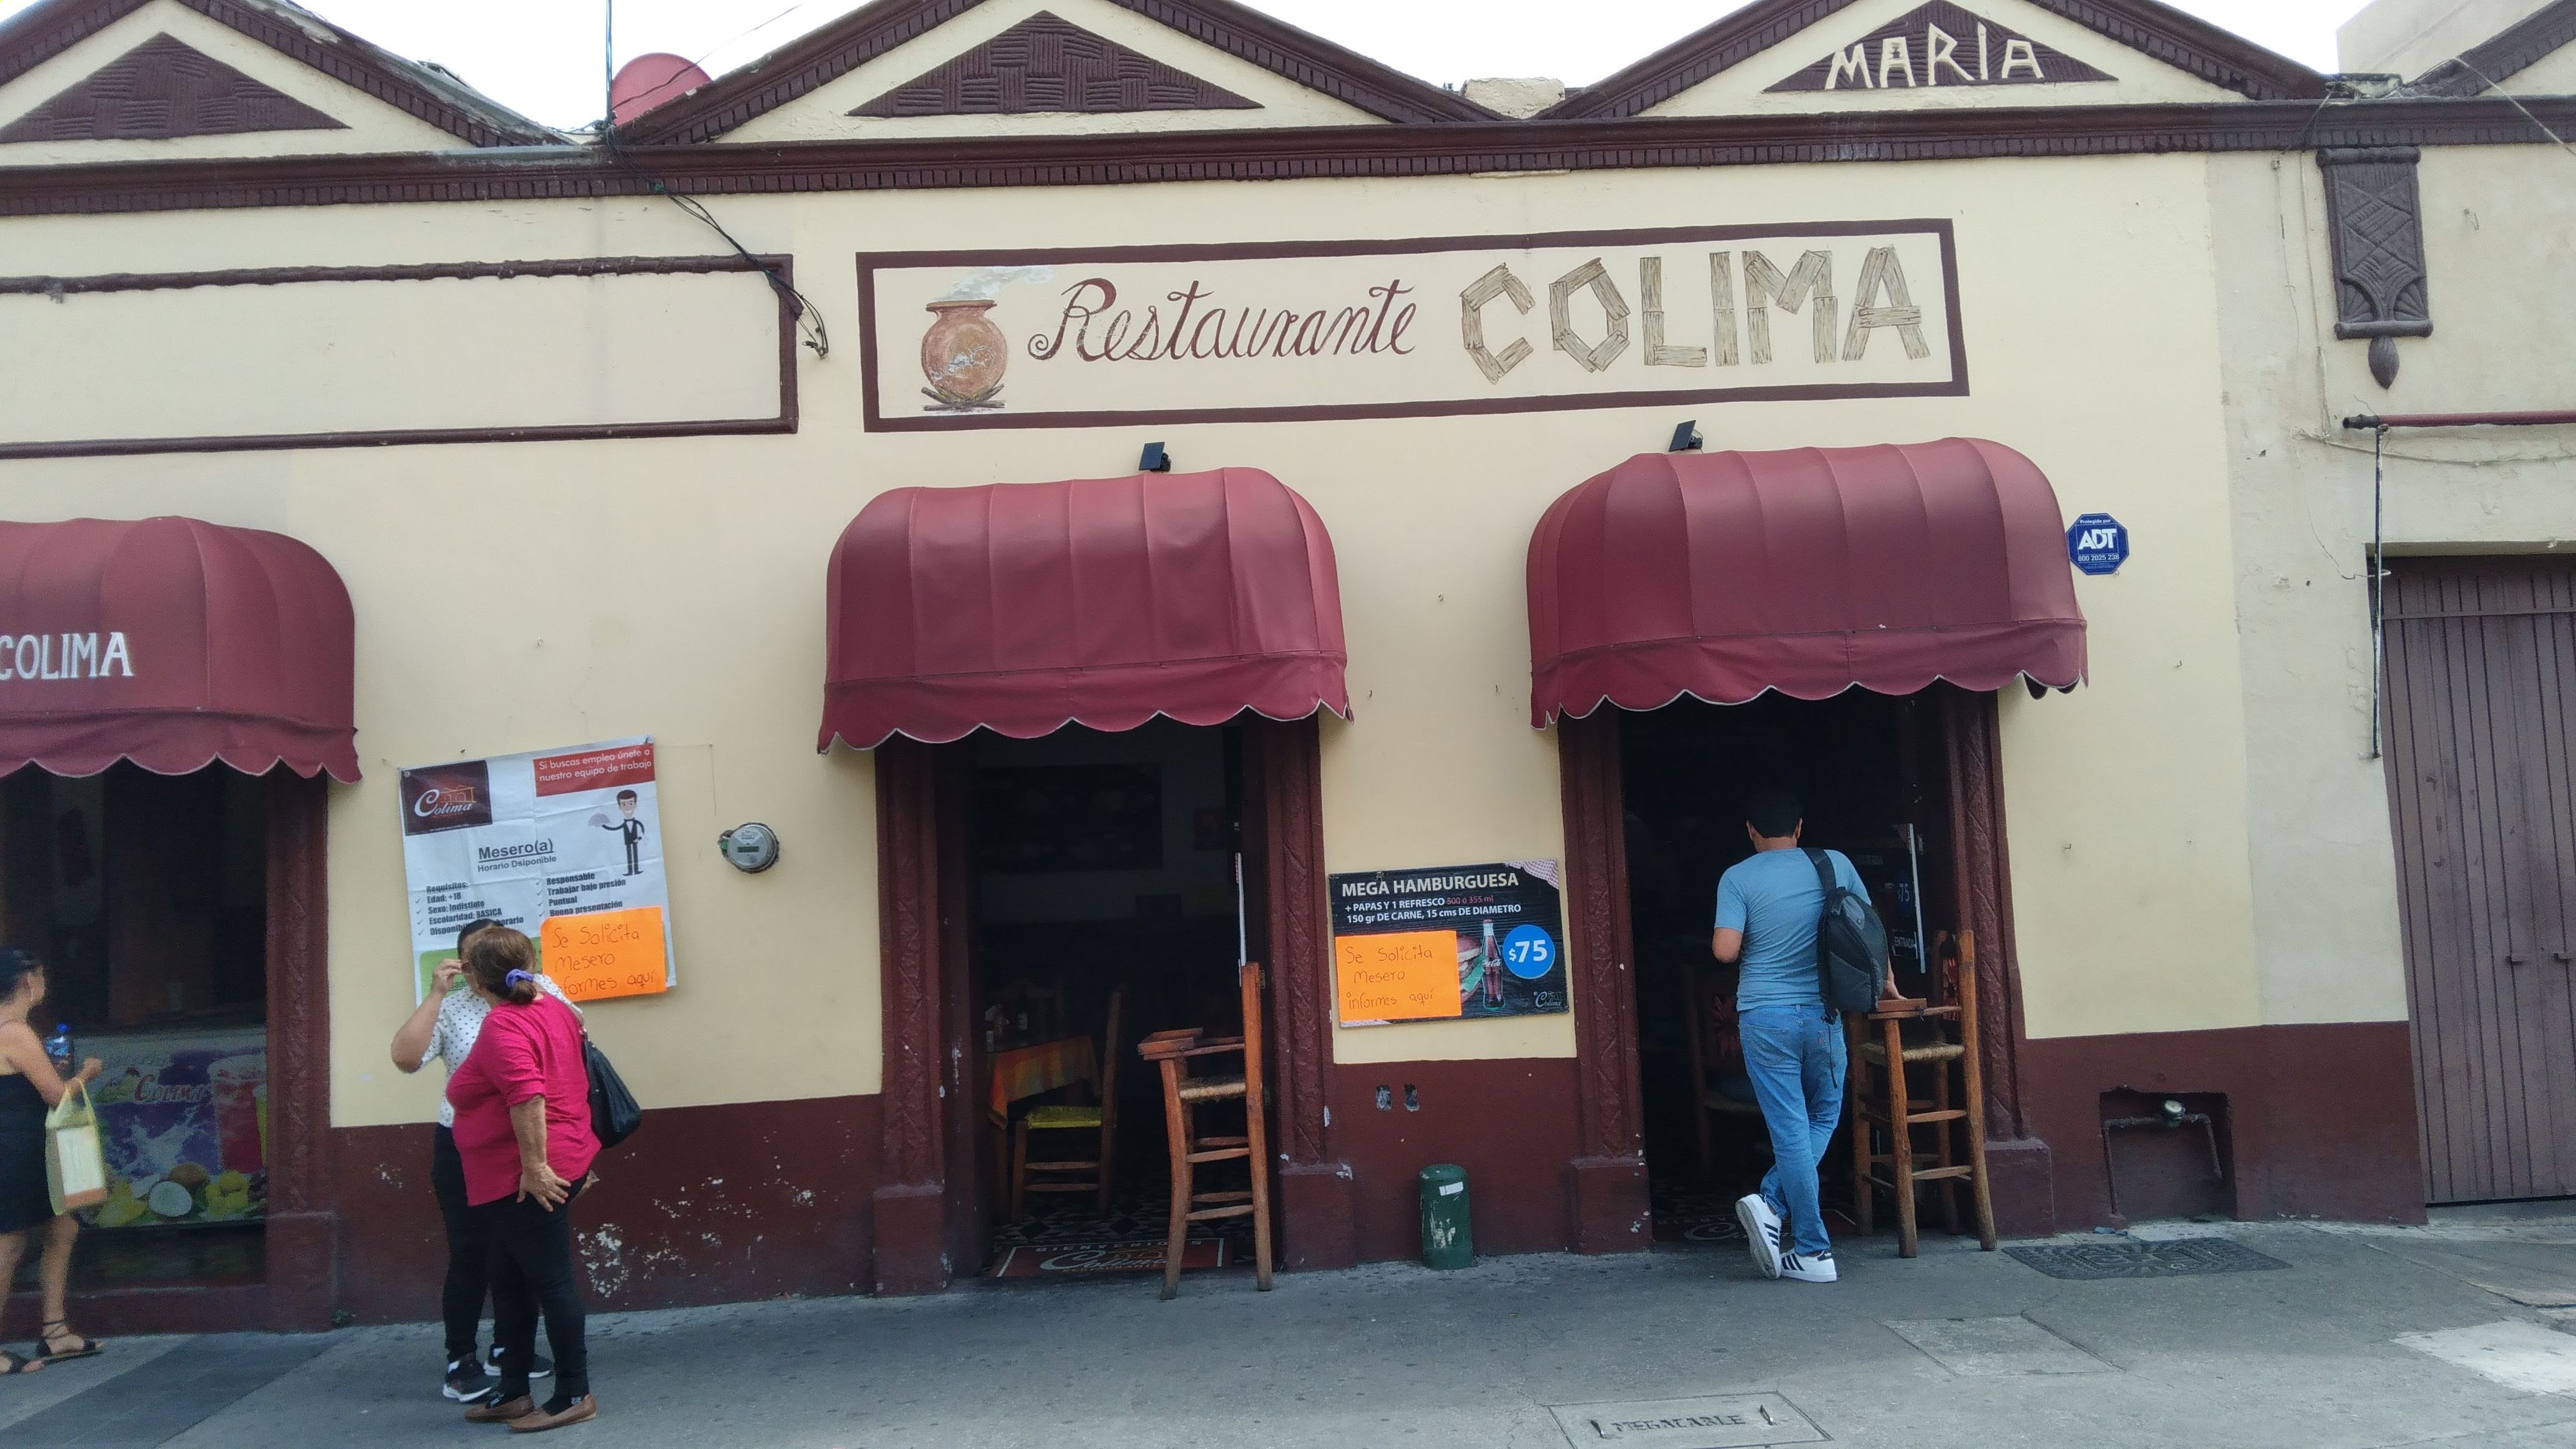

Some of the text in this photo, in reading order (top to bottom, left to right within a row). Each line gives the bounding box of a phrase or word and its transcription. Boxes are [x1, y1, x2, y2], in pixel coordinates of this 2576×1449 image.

[1825, 22, 2044, 90] MARIA
[1028, 245, 1931, 384] Restaurante COLIMA
[2077, 529, 2117, 550] ADT
[0, 632, 135, 680] COLIMA
[539, 761, 547, 770] Si
[550, 758, 580, 769] buscas
[583, 754, 615, 764] empleo
[618, 750, 642, 759] únete
[539, 760, 652, 782] nuestro equipo de trabajo
[414, 789, 473, 816] Colima
[478, 838, 554, 861] Mesero(a)
[477, 856, 557, 872] Horario Dsiponible
[426, 882, 469, 894] Requisitos:
[547, 872, 595, 886] Responsable
[547, 879, 626, 896] Trabajar bajo presión
[1342, 872, 1519, 897] MEGA HAMBURGUESA
[427, 892, 461, 904] Edad: +18
[428, 900, 485, 915] Sexo: Indistinto
[549, 895, 578, 907] Puntual
[1353, 902, 1383, 912] PAPAS
[1383, 901, 1390, 910] Y
[1392, 901, 1397, 909] 1
[1399, 897, 1445, 909] REFRESCO
[429, 907, 502, 925] Escolaridad: BASICA
[550, 900, 623, 917] Buena presentación
[1347, 904, 1521, 924] 150 gr DE CARNE, 15 cms DE DIAMETRO
[553, 927, 569, 948] Se
[1345, 946, 1364, 964] Se
[1508, 939, 1548, 963] $75
[627, 969, 656, 988] aquí
[1346, 988, 1434, 1010] informes aquí
[1035, 1239, 1202, 1252] BIENVENIDS
